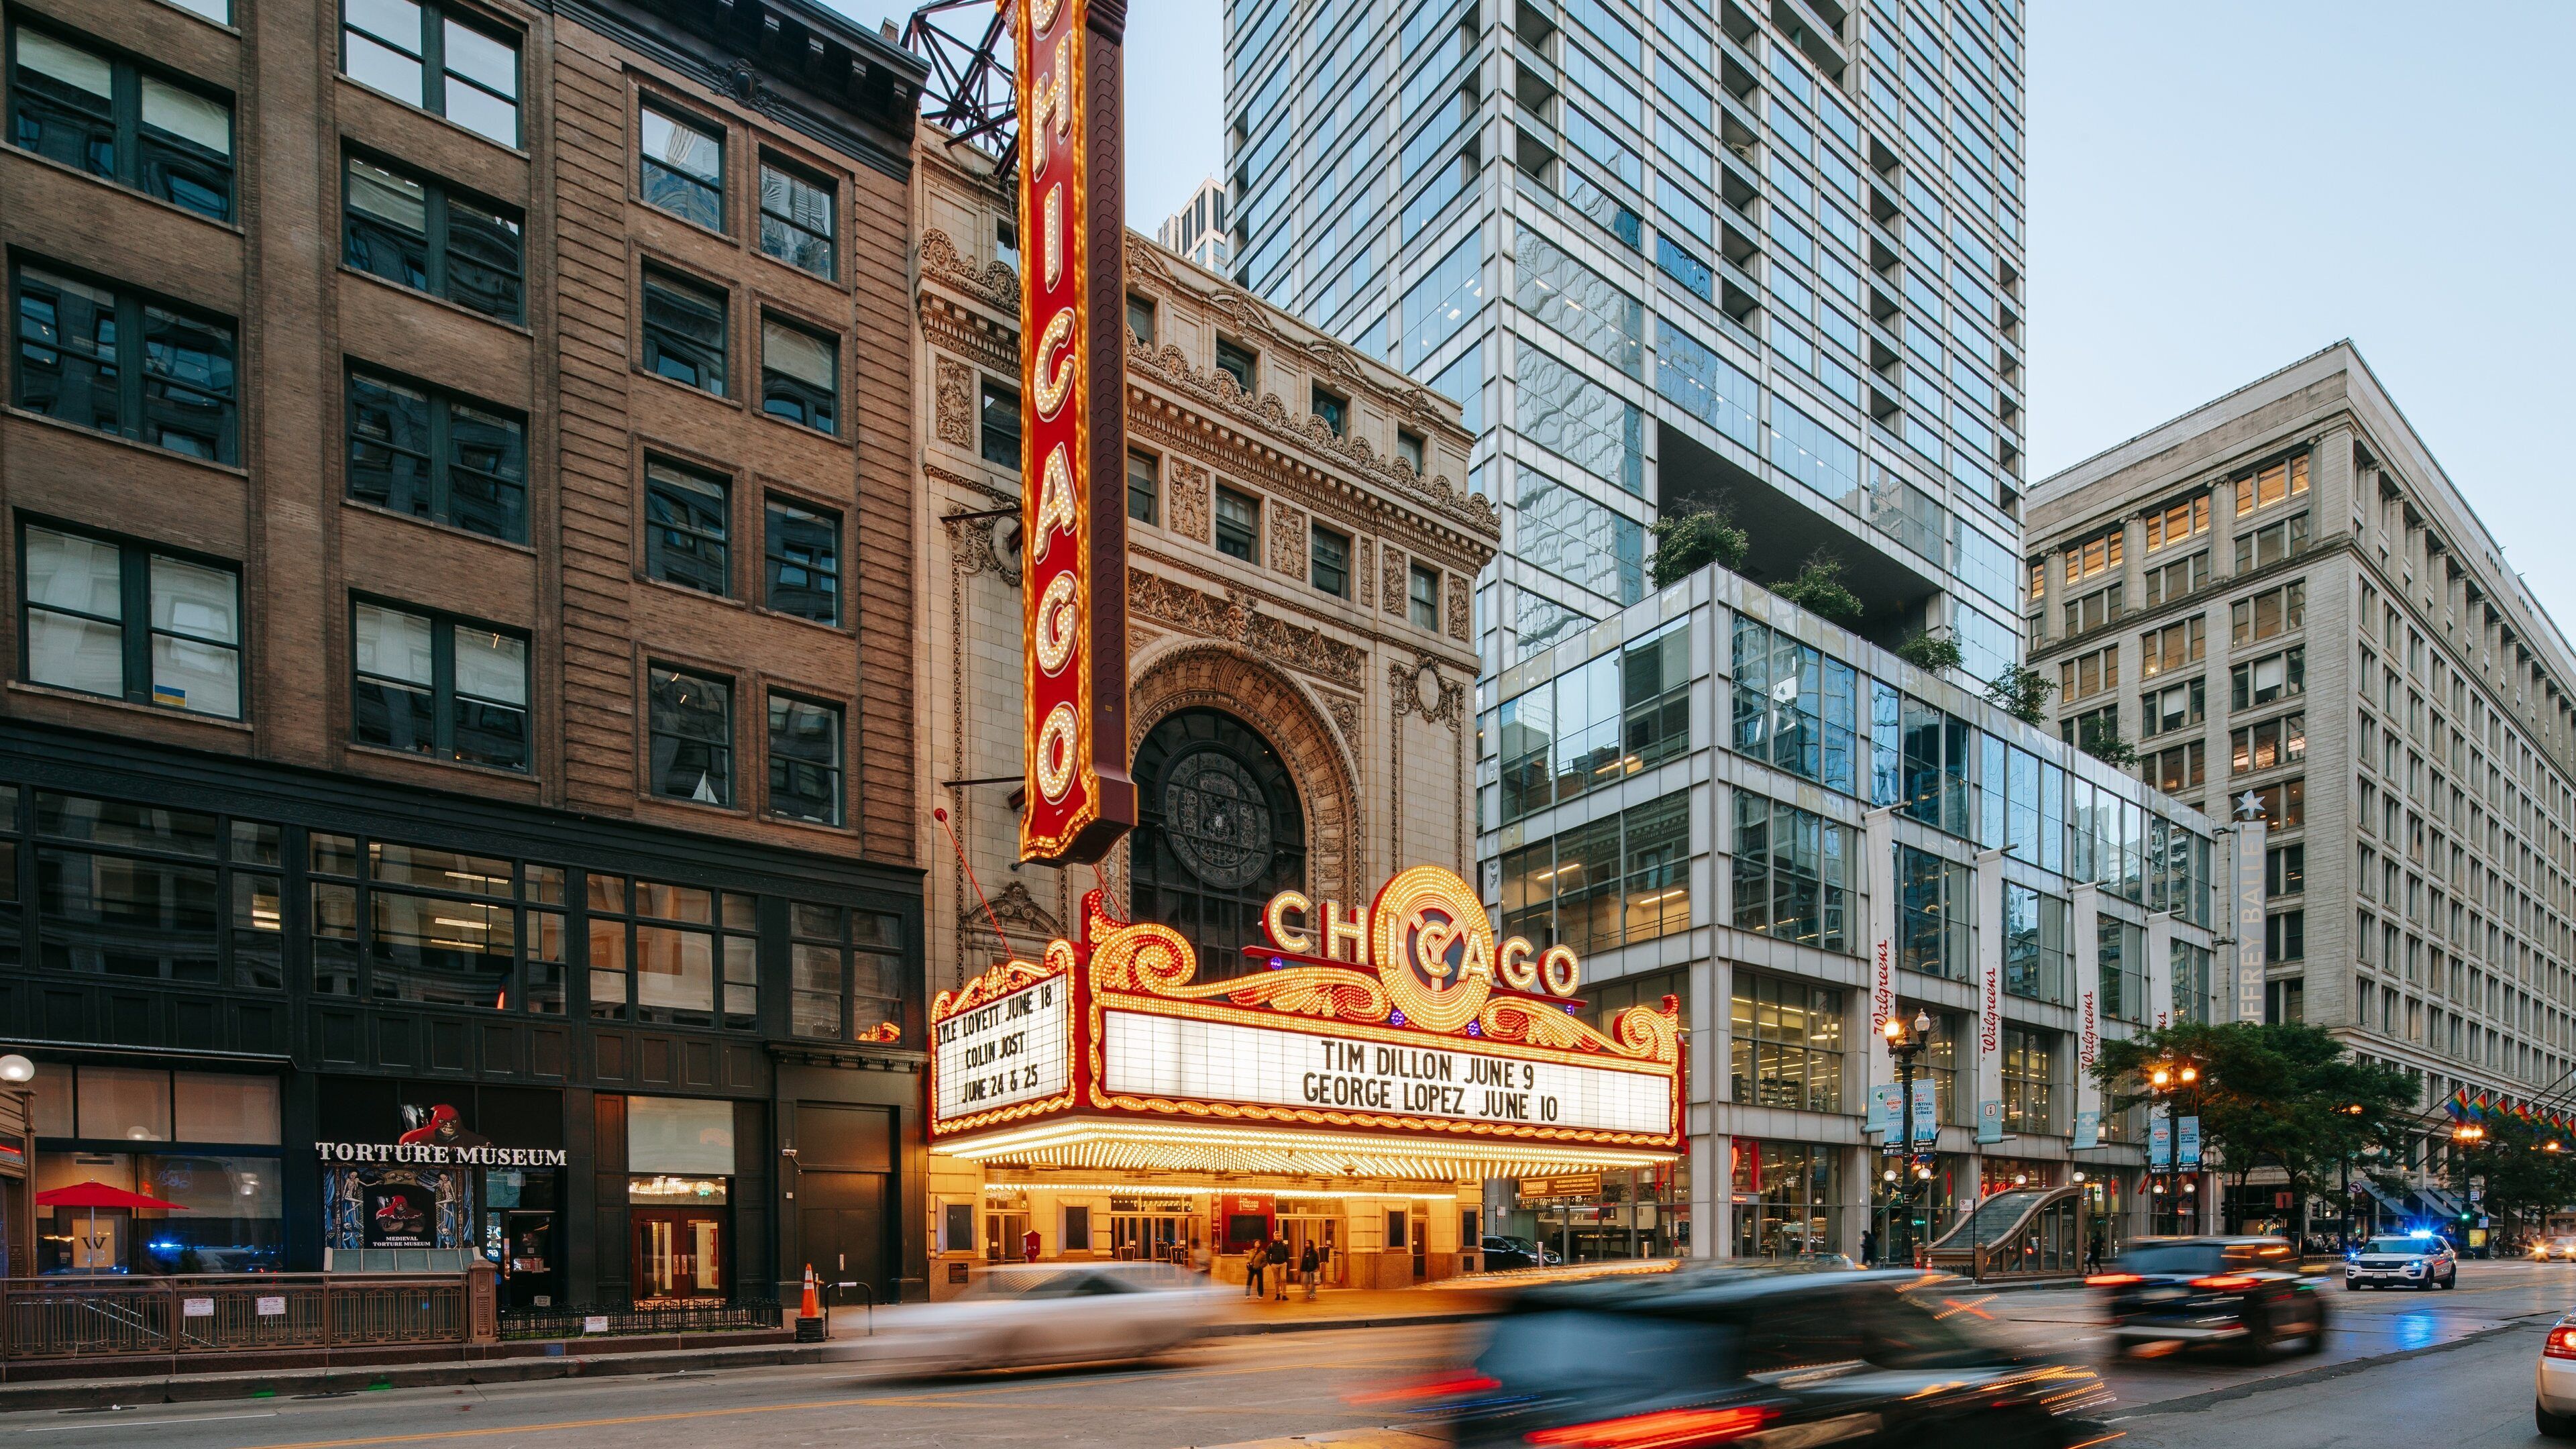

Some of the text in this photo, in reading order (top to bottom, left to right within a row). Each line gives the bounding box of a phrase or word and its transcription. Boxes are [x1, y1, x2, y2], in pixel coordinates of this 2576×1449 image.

[2241, 824, 2263, 924] BALLET
[1264, 890, 1580, 998] CHICAGO
[938, 984, 1053, 1046] LYLE LOVETT JUNE 18
[1872, 939, 1894, 1035] Walgreens
[1982, 967, 2000, 1056] Walgreens
[966, 1031, 1026, 1070] COLIN JOST
[2082, 991, 2098, 1071] Walgreens
[962, 1063, 1038, 1104] JUNE 24 & 25
[1321, 1040, 1534, 1090] TIM DILLON JUNE 9
[1303, 1071, 1558, 1122] GEORGE LOPEZ JUNE 10
[315, 1141, 567, 1166] TORTURE MUSEUM
[82, 1237, 107, 1249] W
